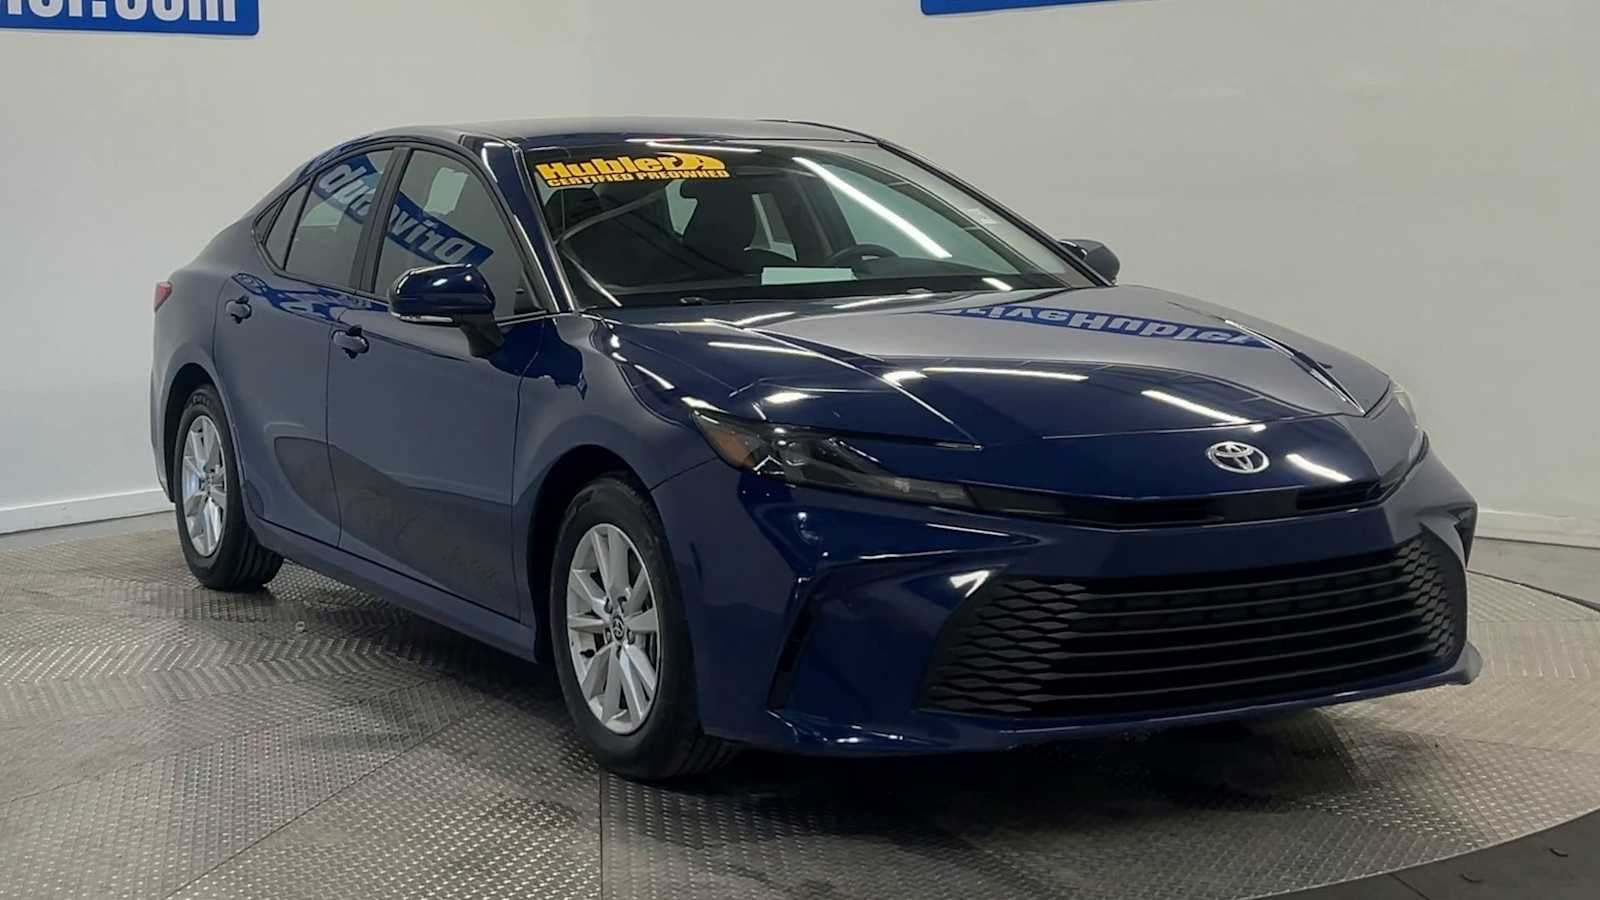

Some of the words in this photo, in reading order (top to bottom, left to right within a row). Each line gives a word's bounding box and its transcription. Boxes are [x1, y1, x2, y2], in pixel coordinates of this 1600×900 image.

[535, 156, 680, 180] Hubler
[546, 172, 635, 187] CERTIFIED
[636, 169, 731, 181] PREOWNED
